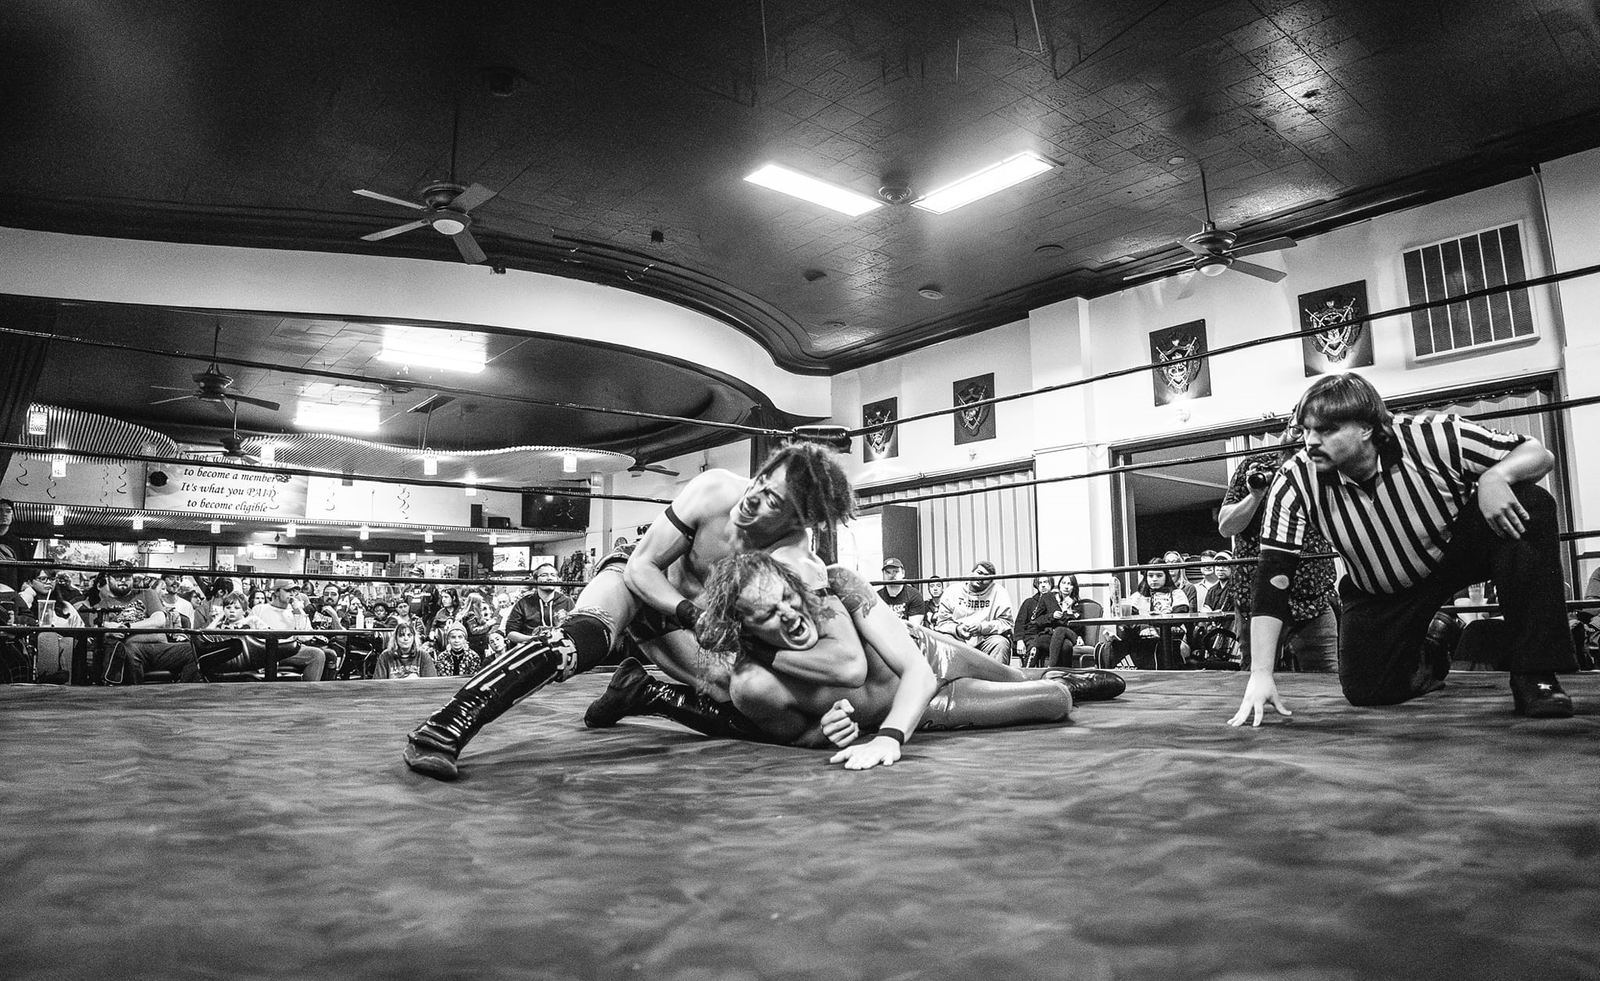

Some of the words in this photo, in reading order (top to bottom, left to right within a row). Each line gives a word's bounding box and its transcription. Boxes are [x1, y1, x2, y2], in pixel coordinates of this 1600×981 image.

[183, 468, 194, 476] to
[197, 467, 230, 479] become
[241, 474, 276, 483] member
[181, 482, 197, 492] It's
[199, 483, 225, 494] what
[226, 488, 244, 497] you
[187, 499, 197, 508] to
[199, 498, 233, 510] become
[235, 501, 268, 514] eligible
